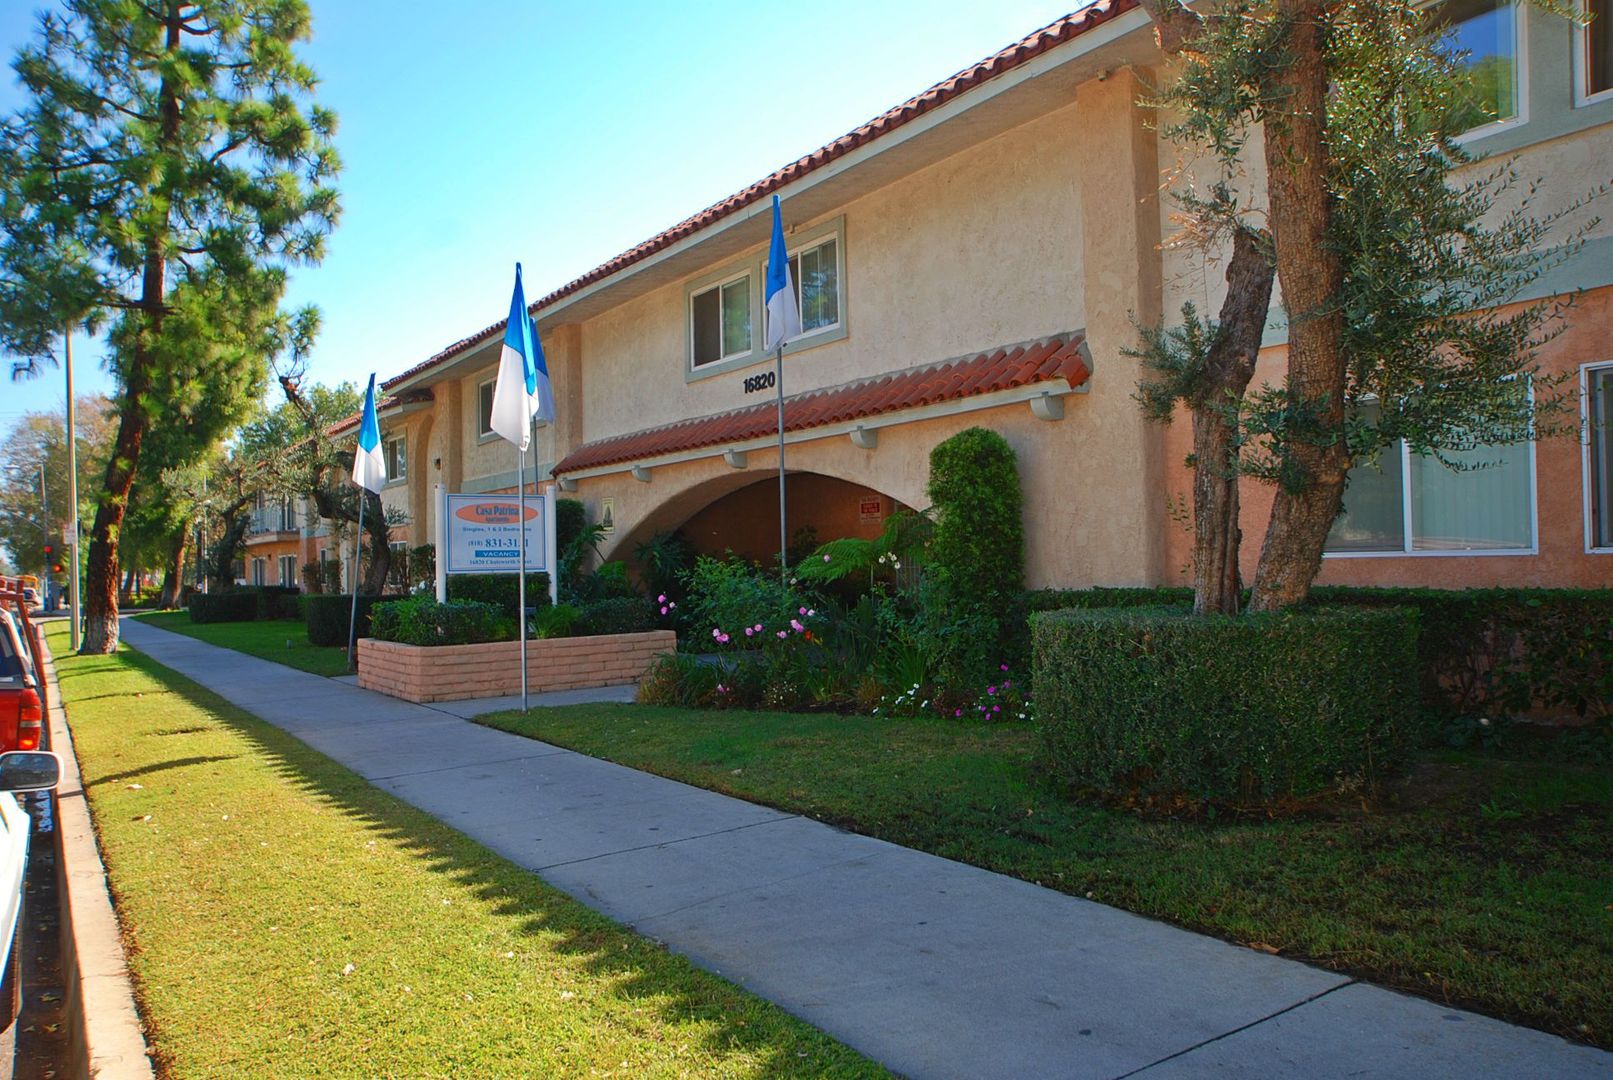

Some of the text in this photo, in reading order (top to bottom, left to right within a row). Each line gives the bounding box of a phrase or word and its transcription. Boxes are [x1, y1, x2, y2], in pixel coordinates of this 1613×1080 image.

[743, 371, 775, 394] 16820
[476, 505, 493, 515] Casa
[485, 538, 528, 548] 831-311
